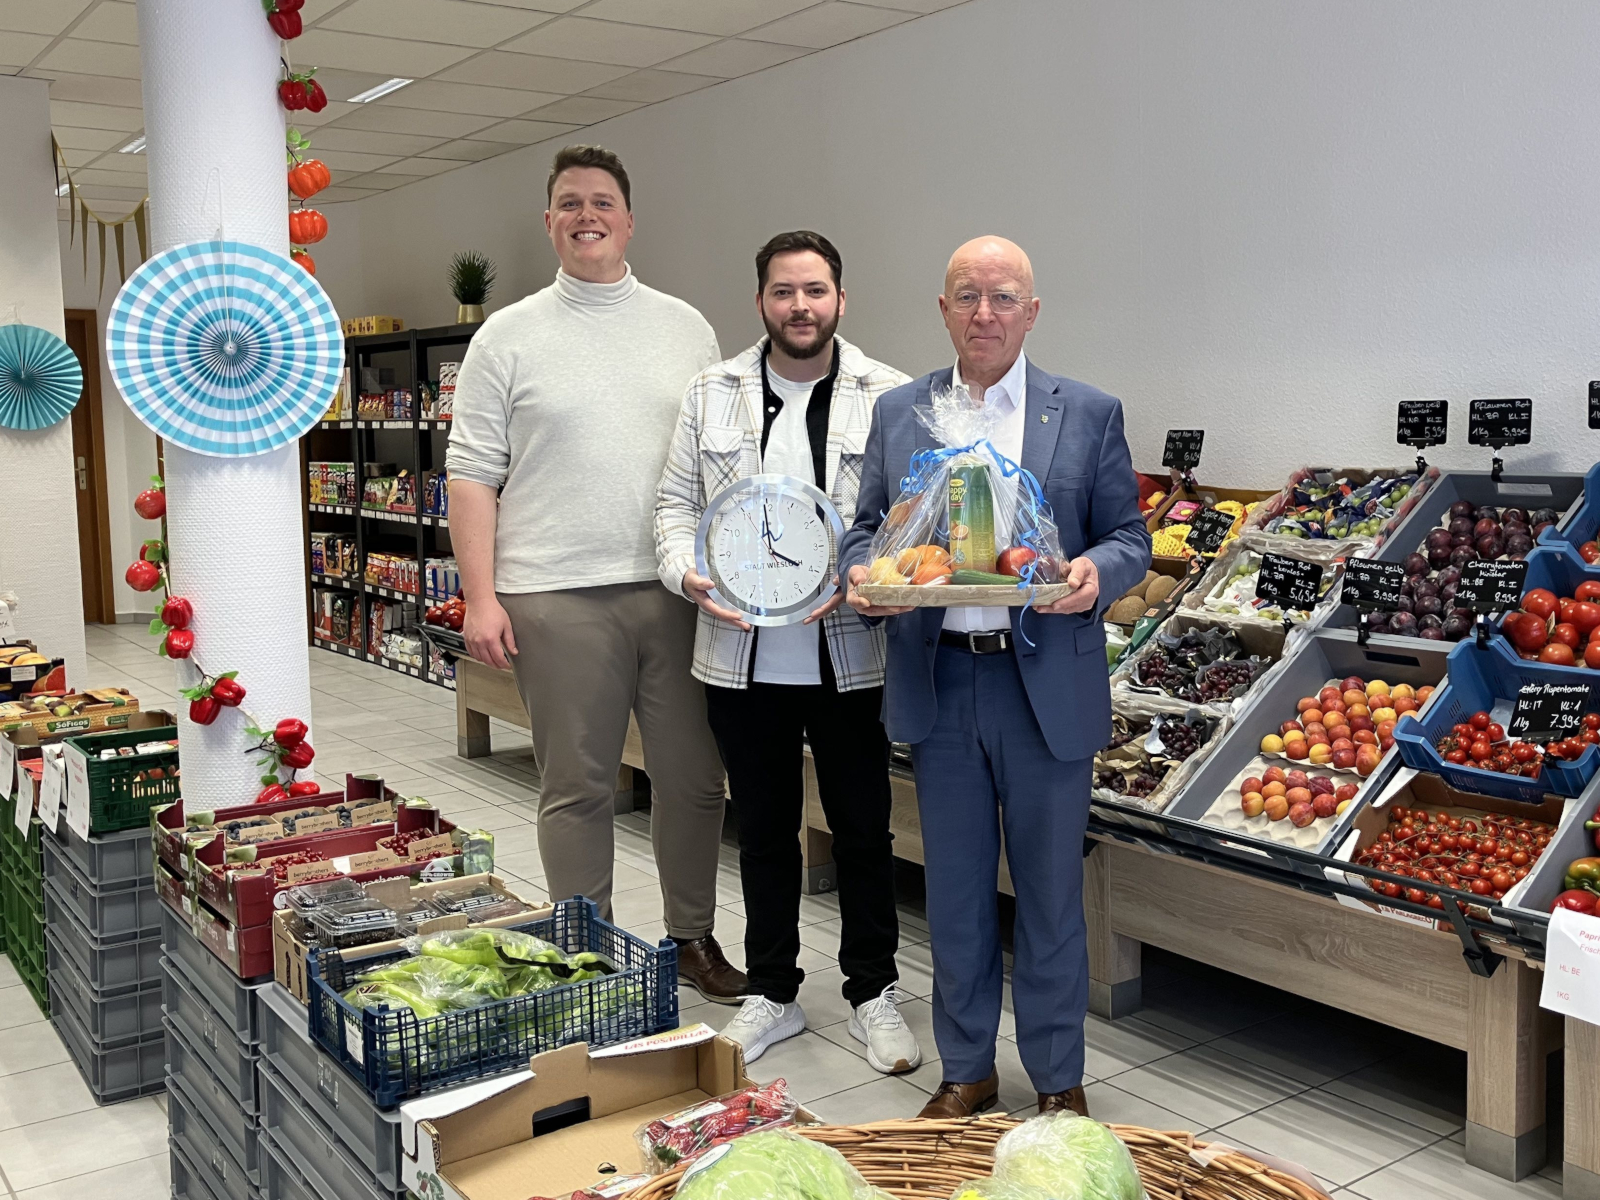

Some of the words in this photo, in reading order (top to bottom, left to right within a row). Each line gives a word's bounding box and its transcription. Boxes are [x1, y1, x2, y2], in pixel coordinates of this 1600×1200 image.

[1400, 401, 1424, 409] Trauben
[1474, 401, 1512, 410] Pflaumen
[1515, 400, 1531, 409] Rot
[787, 506, 791, 515] 1
[804, 521, 810, 530] 2
[730, 528, 741, 538] 10
[813, 543, 818, 551] 3
[725, 550, 732, 558] 9
[766, 559, 803, 568] WIESLOH
[1266, 554, 1294, 566] Trauben
[1298, 561, 1311, 570] Rot
[1349, 558, 1383, 570] Pflaumen
[1385, 565, 1404, 574] gelb
[1468, 561, 1523, 571] Cherrytomaten
[734, 571, 740, 579] 8
[751, 585, 757, 593] 7
[793, 581, 800, 589] 5
[772, 589, 779, 598] 6
[1543, 683, 1590, 696] Rispentomate
[1559, 963, 1570, 973] HL:
[1571, 967, 1581, 976] BE
[624, 1042, 644, 1050] LAS
[646, 1029, 709, 1046] POSADILLAS
